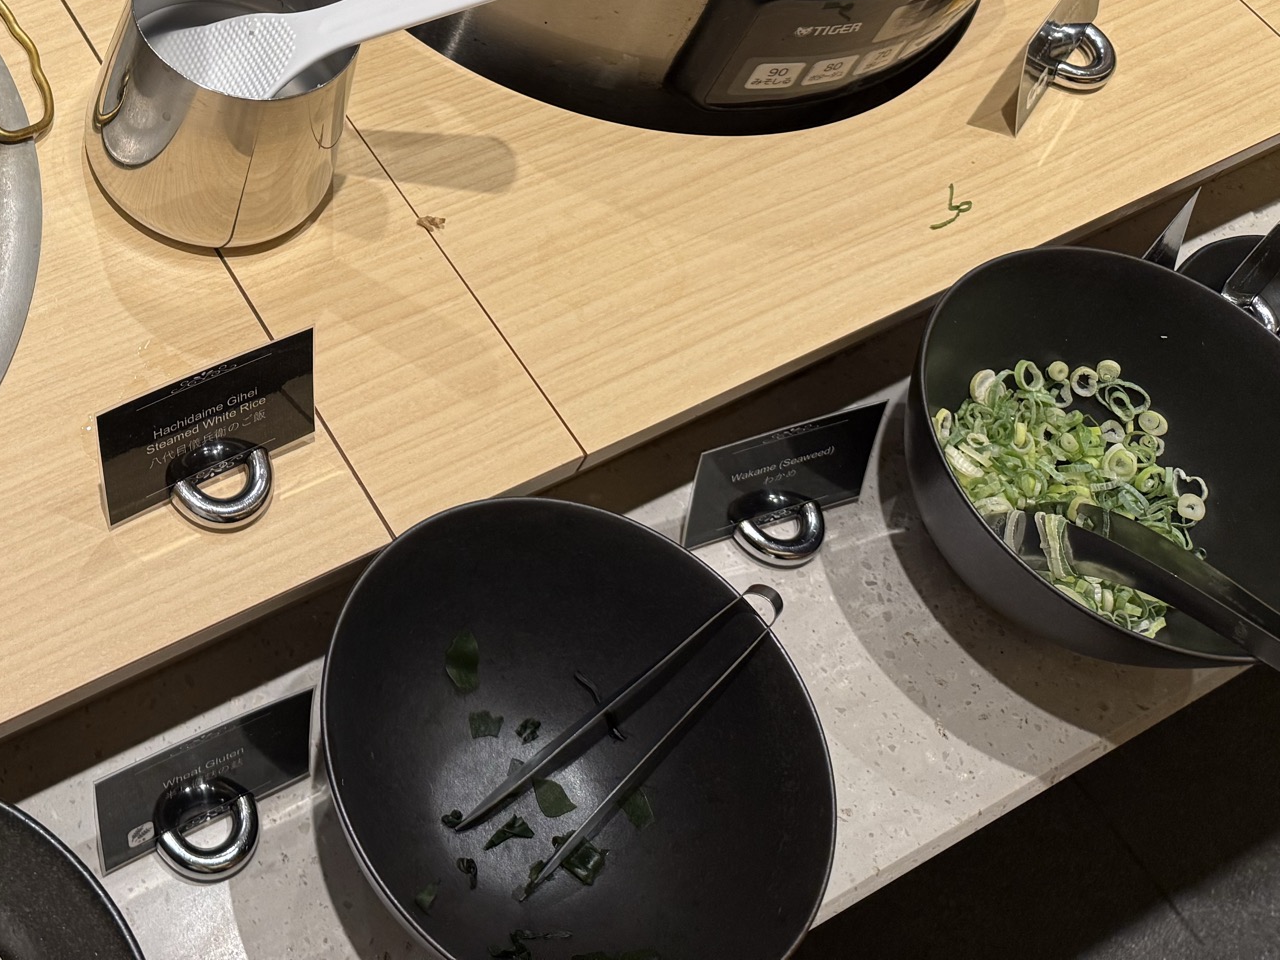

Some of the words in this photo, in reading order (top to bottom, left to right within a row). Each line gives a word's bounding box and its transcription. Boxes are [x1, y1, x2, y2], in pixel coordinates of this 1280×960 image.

[812, 22, 862, 36] TIGER
[767, 67, 789, 78] 90
[823, 61, 843, 72] 80
[750, 77, 792, 86] みそしる
[146, 424, 200, 456] Steamed
[202, 409, 237, 431] White
[240, 396, 267, 417] Rice
[152, 402, 224, 440] Hachidaime
[226, 386, 259, 408] Gihei
[731, 463, 777, 484] Wakame
[778, 445, 836, 471] (Seaweed)
[162, 767, 202, 790] Wheat
[205, 747, 245, 770] Gluten
